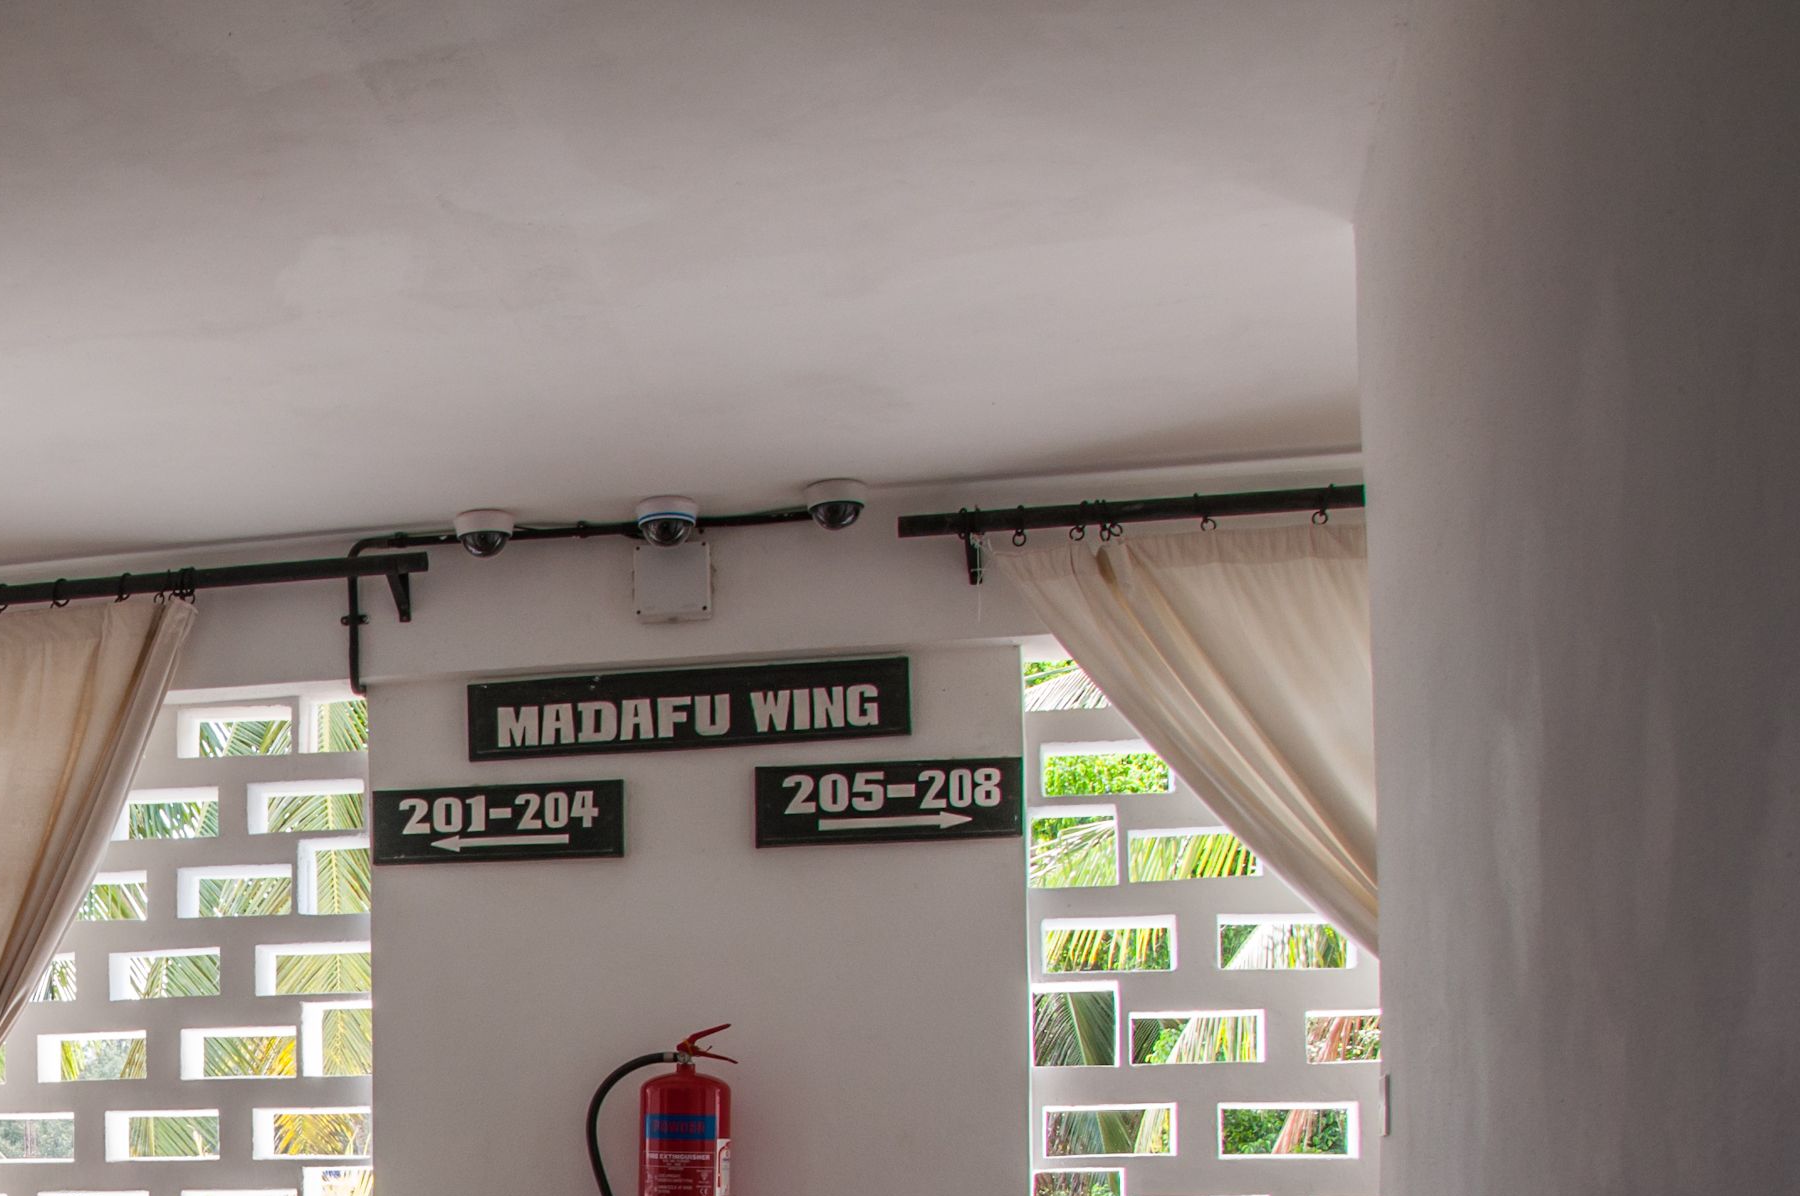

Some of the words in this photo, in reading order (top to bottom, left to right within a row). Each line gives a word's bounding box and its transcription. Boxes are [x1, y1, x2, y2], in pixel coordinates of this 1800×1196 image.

[496, 692, 731, 748] MADAFU
[750, 683, 880, 733] WING
[398, 789, 600, 836] 201-204
[781, 767, 1001, 815] 205-208
